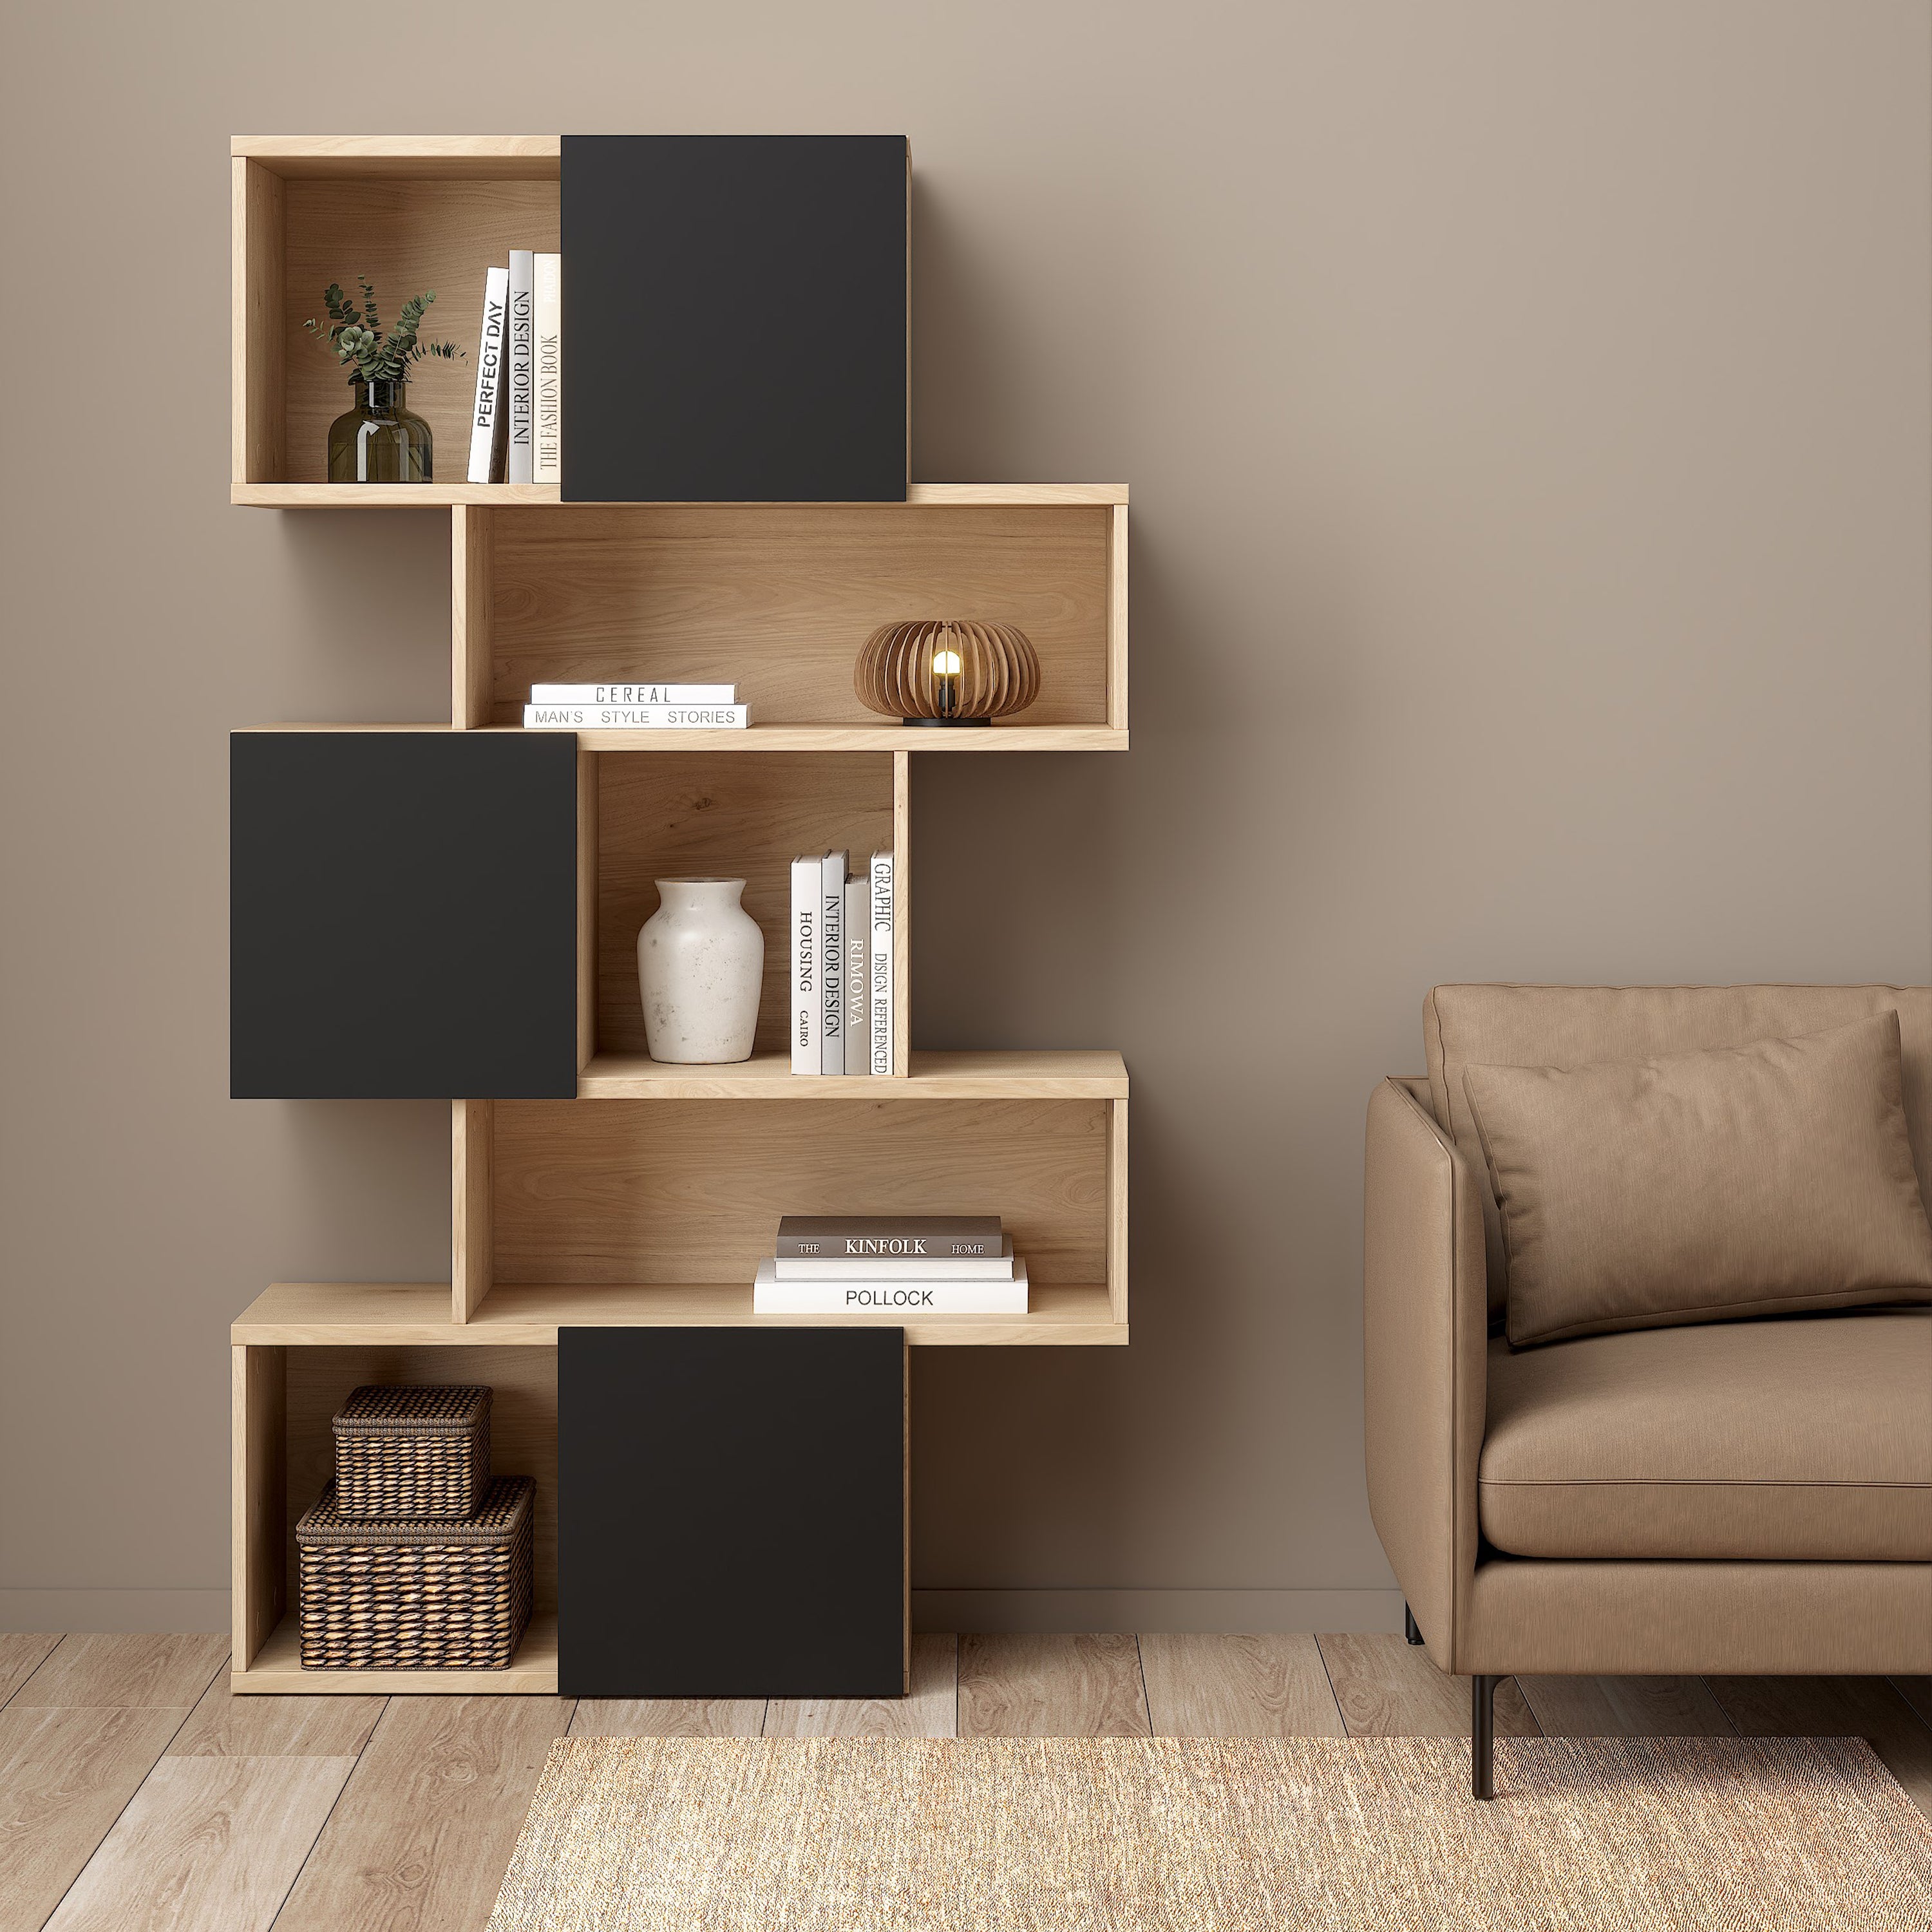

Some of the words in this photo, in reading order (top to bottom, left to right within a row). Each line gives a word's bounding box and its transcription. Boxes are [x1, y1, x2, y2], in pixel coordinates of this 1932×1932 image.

[544, 260, 556, 303] PHAIDON
[486, 301, 503, 337] DAY
[514, 291, 529, 357] DESIGN
[540, 334, 557, 375] BOOK
[478, 342, 498, 428] PERFECT
[514, 361, 529, 445] INTERIOR
[540, 379, 557, 437] FASHION
[540, 443, 557, 470] THE
[535, 710, 583, 723] MAN'S
[601, 710, 650, 723] STYLE
[668, 710, 735, 723] STORIES
[596, 687, 671, 703] CEREAL
[874, 863, 891, 933] GRAPHIC
[800, 911, 812, 992] HOUSING
[825, 895, 840, 972] INTERIOR
[850, 938, 864, 1027] RIMOWA
[875, 953, 887, 993] DISIGN
[800, 1010, 809, 1047] CAIRO
[825, 978, 840, 1038] DESIGN
[875, 998, 887, 1074] REFERENCED
[798, 1243, 820, 1254] THE
[844, 1238, 927, 1255] KINFOLK
[951, 1244, 985, 1255] HOME
[846, 1290, 934, 1306] POLLOCK
